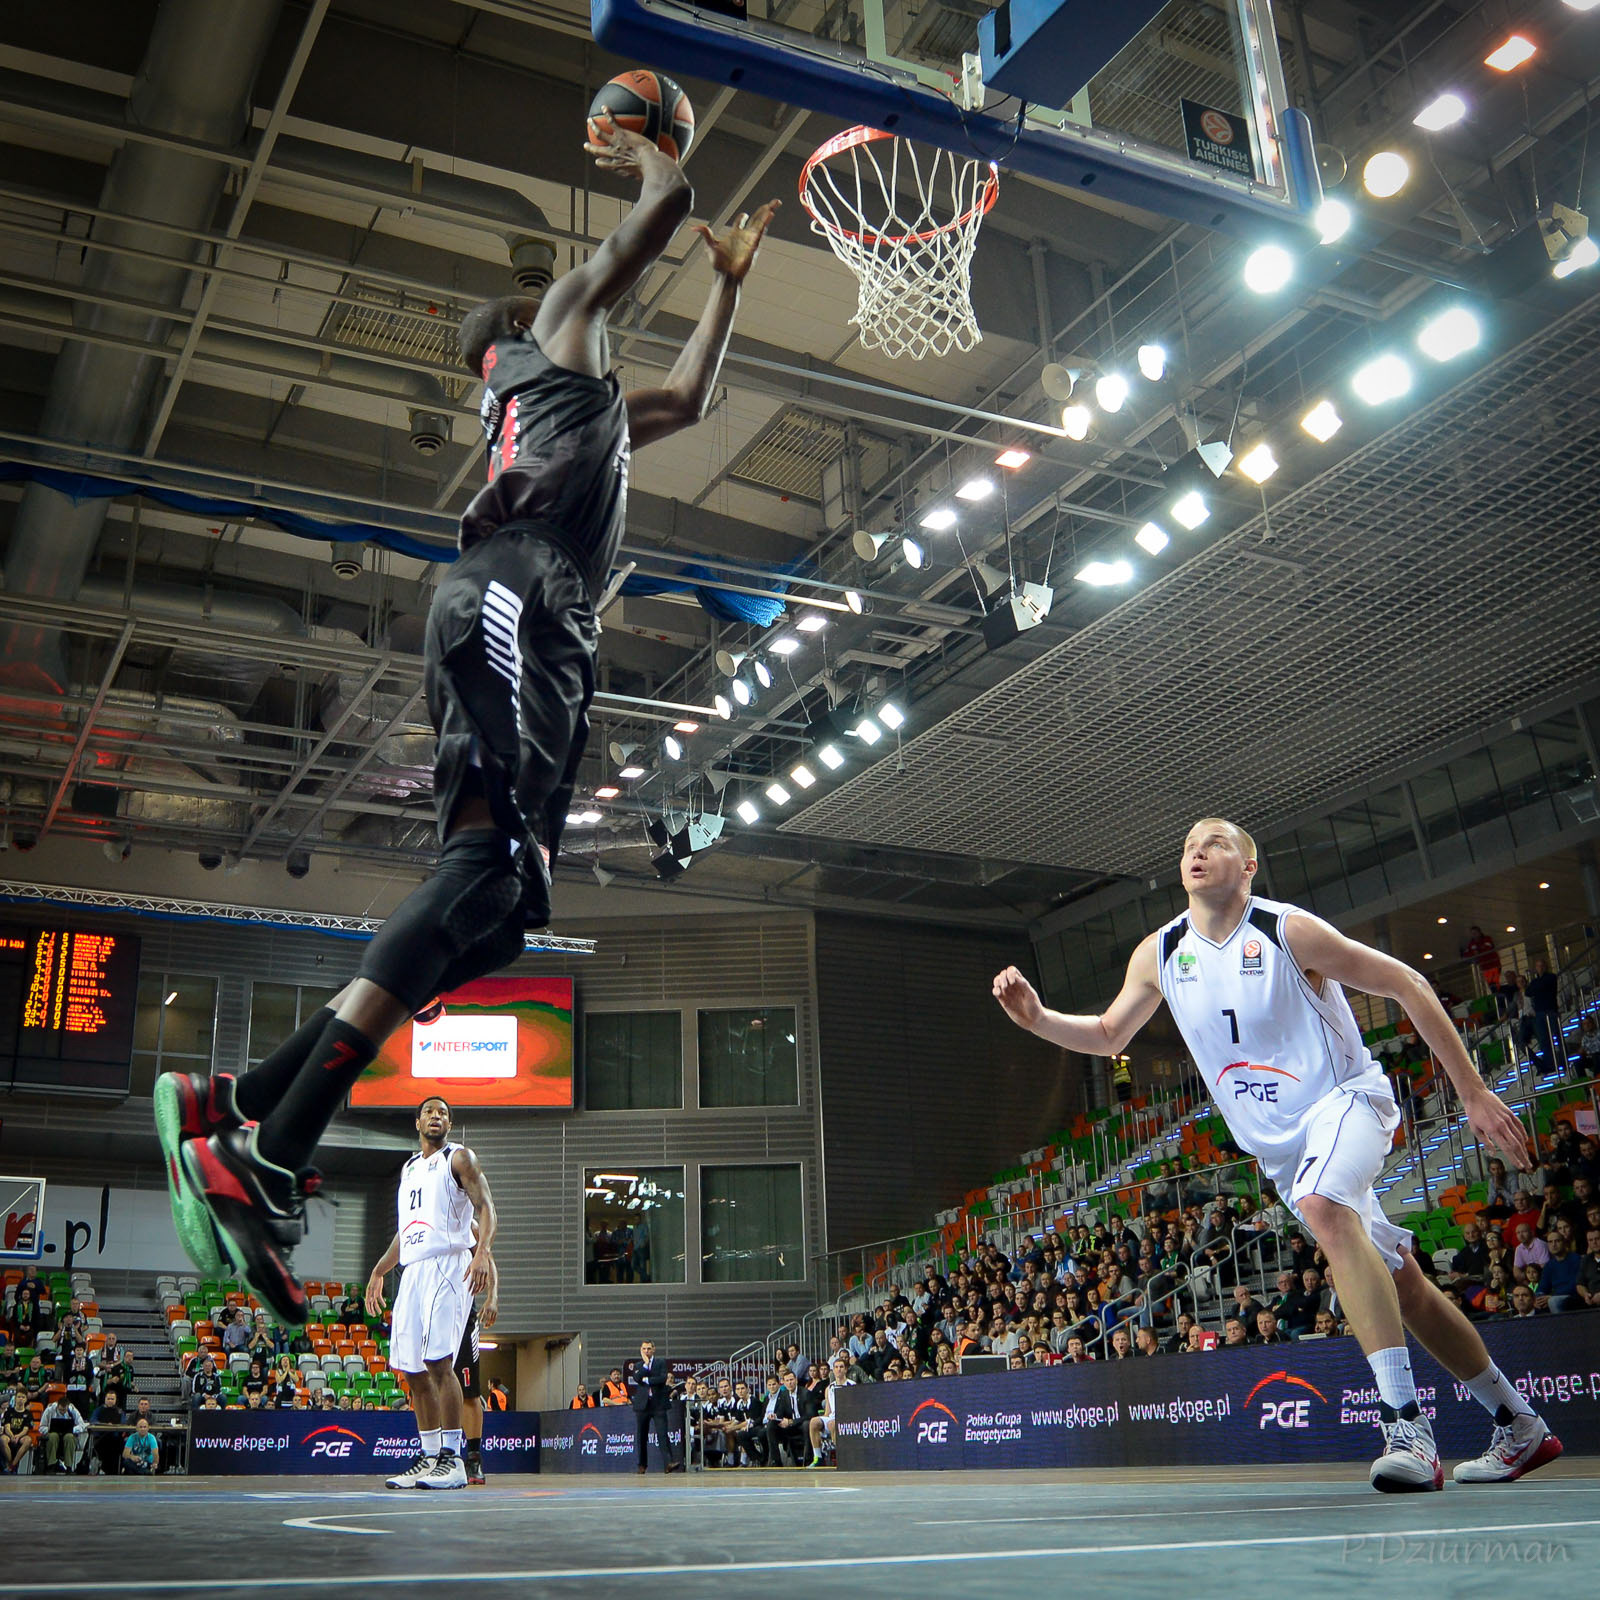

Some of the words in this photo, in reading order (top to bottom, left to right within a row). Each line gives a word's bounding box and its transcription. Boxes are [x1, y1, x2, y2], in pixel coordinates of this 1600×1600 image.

[1193, 137, 1248, 162] TURKISH
[1195, 149, 1250, 173] AIRLINES
[433, 1041, 508, 1052] INTERSPORT
[1233, 1080, 1279, 1102] PGE
[410, 1187, 422, 1211] 21
[404, 1230, 426, 1248] PGE
[672, 1362, 703, 1372] 2014-15
[461, 1367, 470, 1387] 1
[1031, 1401, 1119, 1429] www.gkpge.pl
[1128, 1393, 1231, 1424] www.gkpge.pl
[1259, 1400, 1310, 1430] PGE
[837, 1415, 901, 1438] www.gkpge.pl
[966, 1413, 993, 1427] Polska
[994, 1412, 1022, 1430] Grupa
[375, 1437, 408, 1447] Polska
[917, 1421, 949, 1444] PGE
[965, 1427, 1022, 1445] Energetyczna
[195, 1435, 289, 1451] www.gkpge.pl
[311, 1441, 354, 1457] PGE
[580, 1439, 598, 1455] PGE
[372, 1447, 422, 1459] Energetyc
